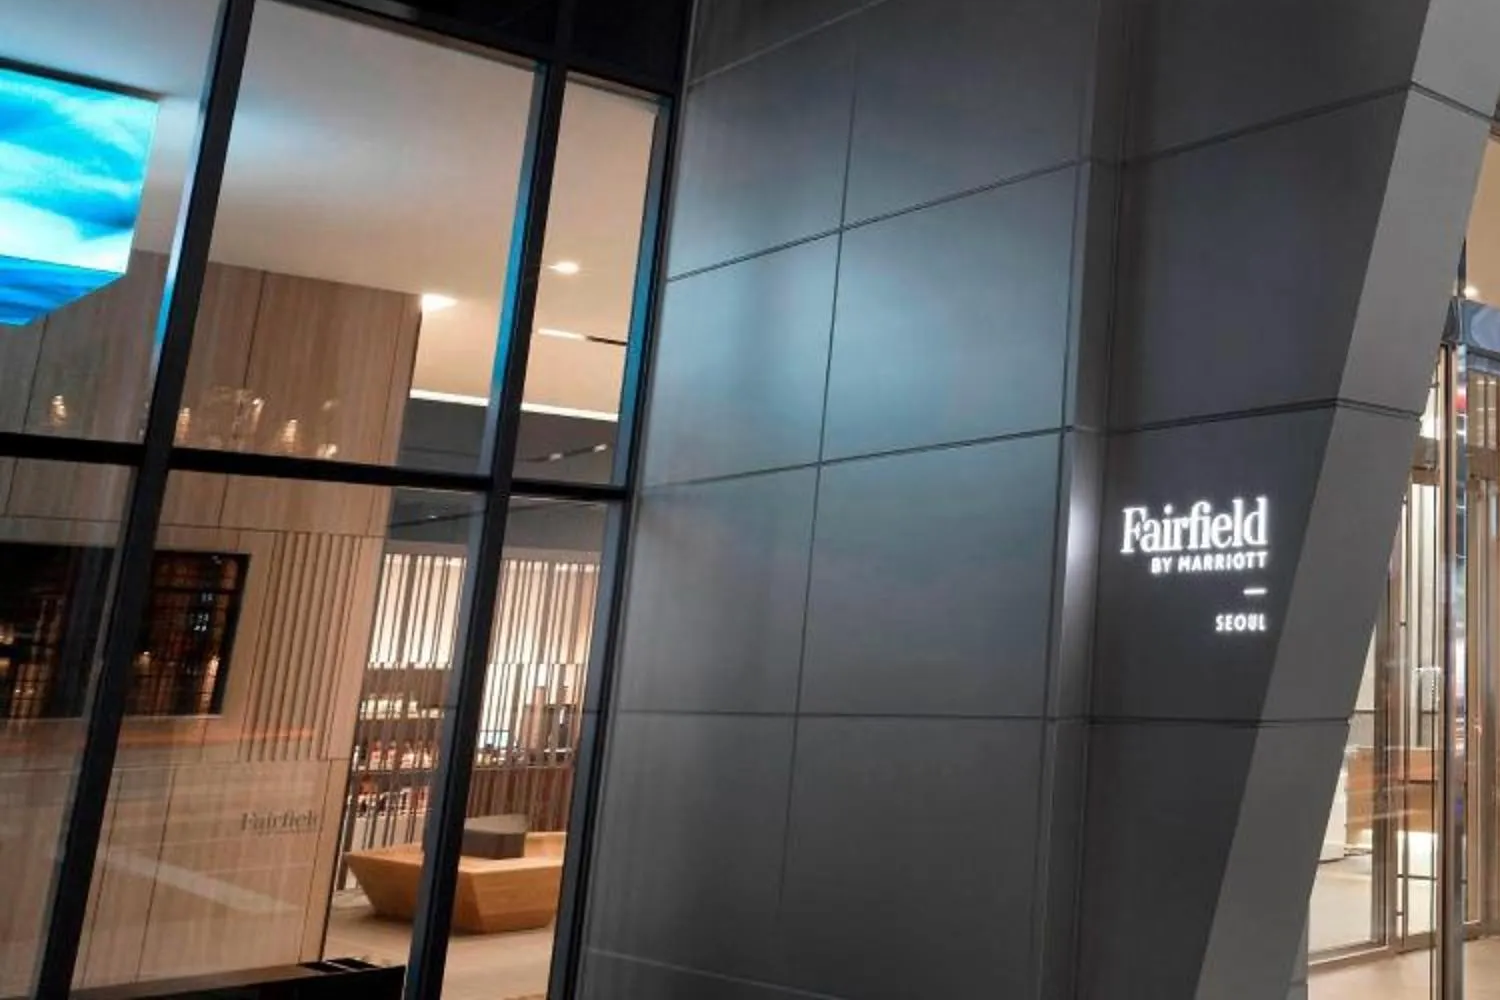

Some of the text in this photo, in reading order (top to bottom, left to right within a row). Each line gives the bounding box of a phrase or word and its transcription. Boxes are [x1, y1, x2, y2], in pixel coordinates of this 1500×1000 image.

[1120, 495, 1268, 553] Fairfield
[1150, 551, 1268, 574] BY MARRIOTT
[1215, 613, 1266, 632] SEOUL
